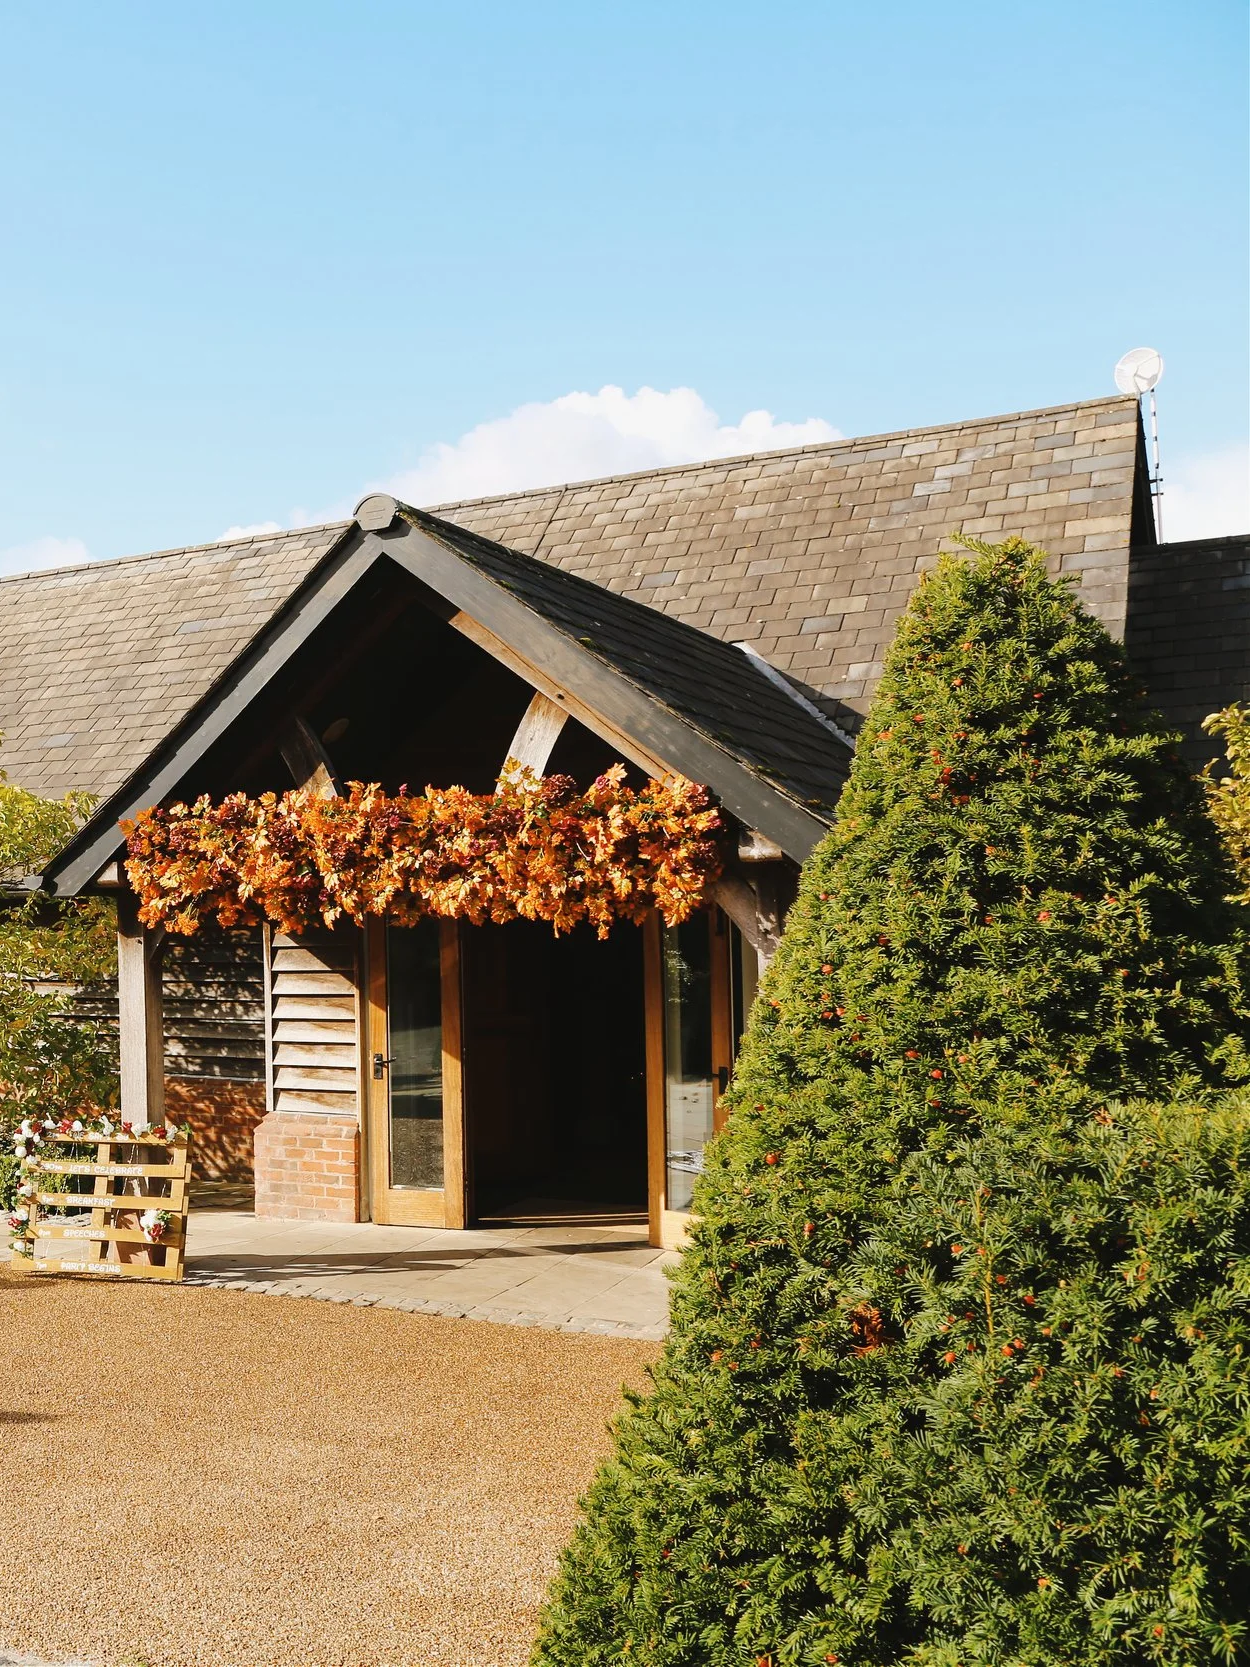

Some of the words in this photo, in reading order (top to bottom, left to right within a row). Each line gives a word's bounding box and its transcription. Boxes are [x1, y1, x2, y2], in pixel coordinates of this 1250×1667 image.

[69, 1164, 90, 1173] LET'S
[94, 1165, 143, 1175] CELEBRATE
[66, 1196, 115, 1206] BREAKFAST
[63, 1229, 106, 1238] SPEECHES
[60, 1262, 85, 1271] PARTY
[87, 1263, 121, 1273] BEGINS
